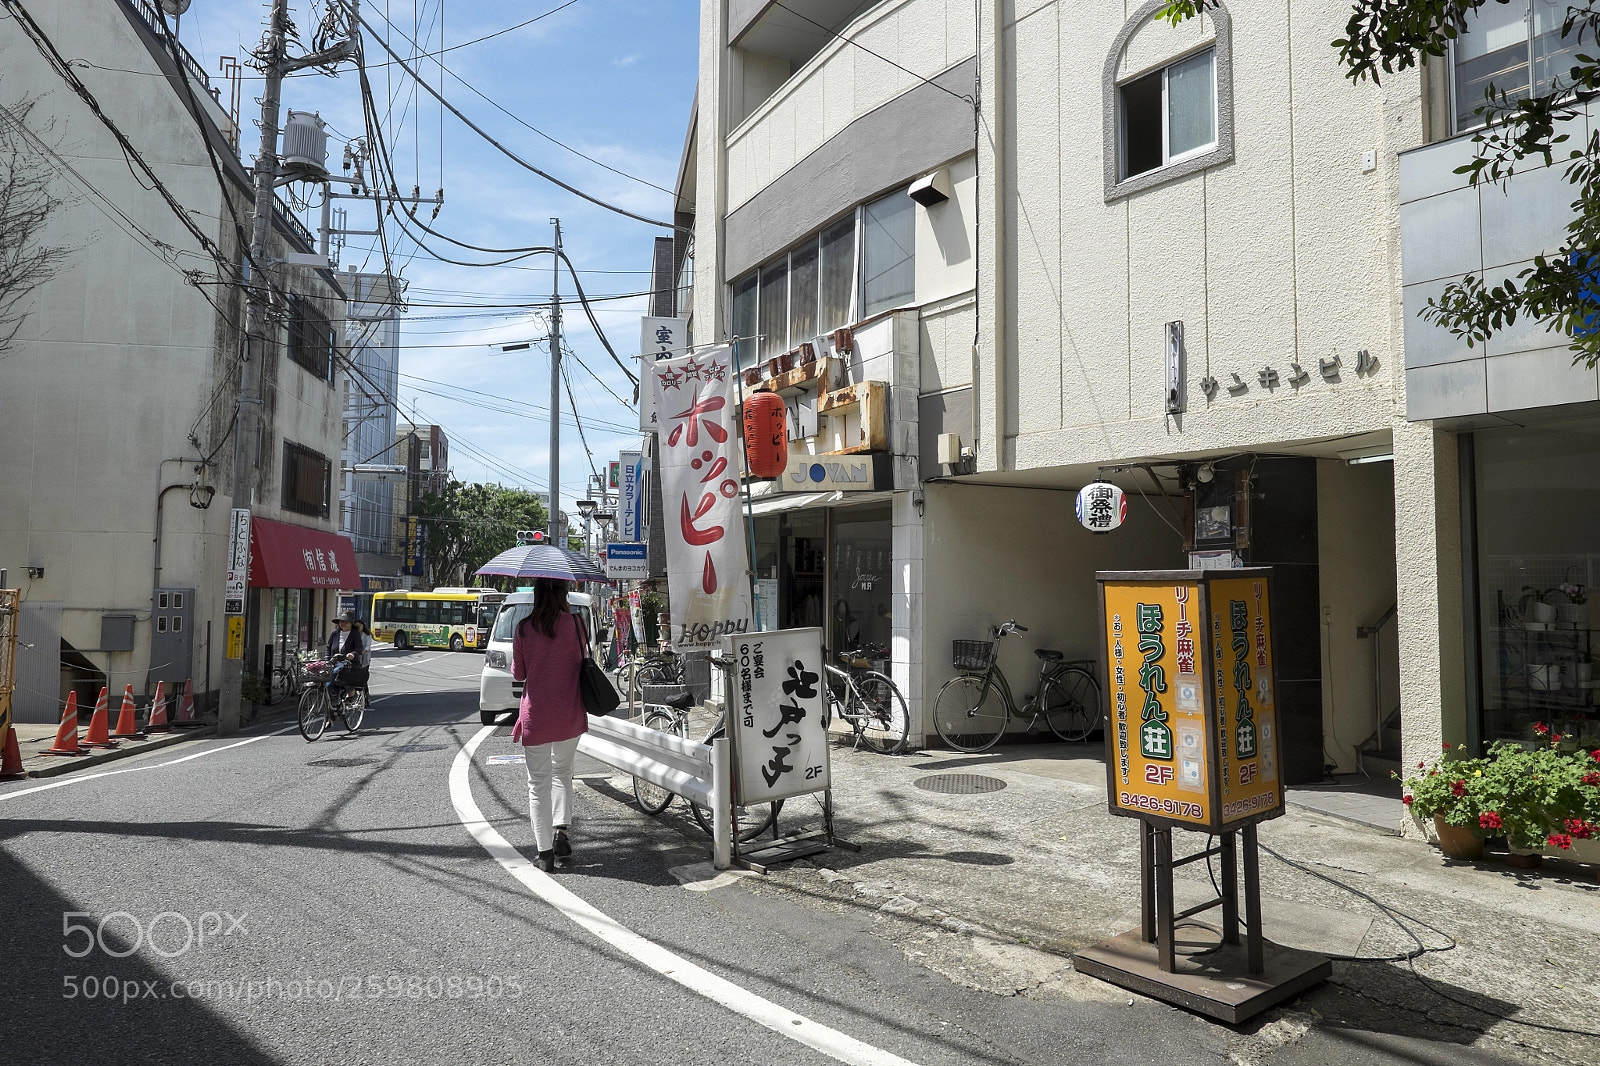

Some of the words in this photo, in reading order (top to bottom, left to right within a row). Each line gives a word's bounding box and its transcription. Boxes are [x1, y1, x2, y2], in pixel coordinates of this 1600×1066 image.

[1199, 350, 1377, 396] サンキンビル
[771, 405, 784, 462] ホッピー
[668, 383, 738, 595] ホッピー
[790, 463, 867, 483] JOVAN
[624, 465, 635, 536] 日立カラーテレビ
[235, 514, 248, 567] ちとふな
[678, 618, 748, 643] Hoppy
[1174, 586, 1195, 675] リーチ麻雀
[1254, 581, 1268, 668] リーチ麻雀
[740, 644, 754, 728] 60名様まで可
[753, 642, 765, 679] ご宴会
[1137, 603, 1173, 759] ほうれん荘
[1230, 600, 1257, 760] ほうれん荘
[761, 659, 819, 788] 江戸っ子
[805, 766, 823, 780] 2F
[1145, 764, 1175, 785] 2F
[1239, 763, 1259, 785] 2F
[1120, 792, 1203, 819] 3426-9178
[1223, 792, 1276, 818] 3426-9178
